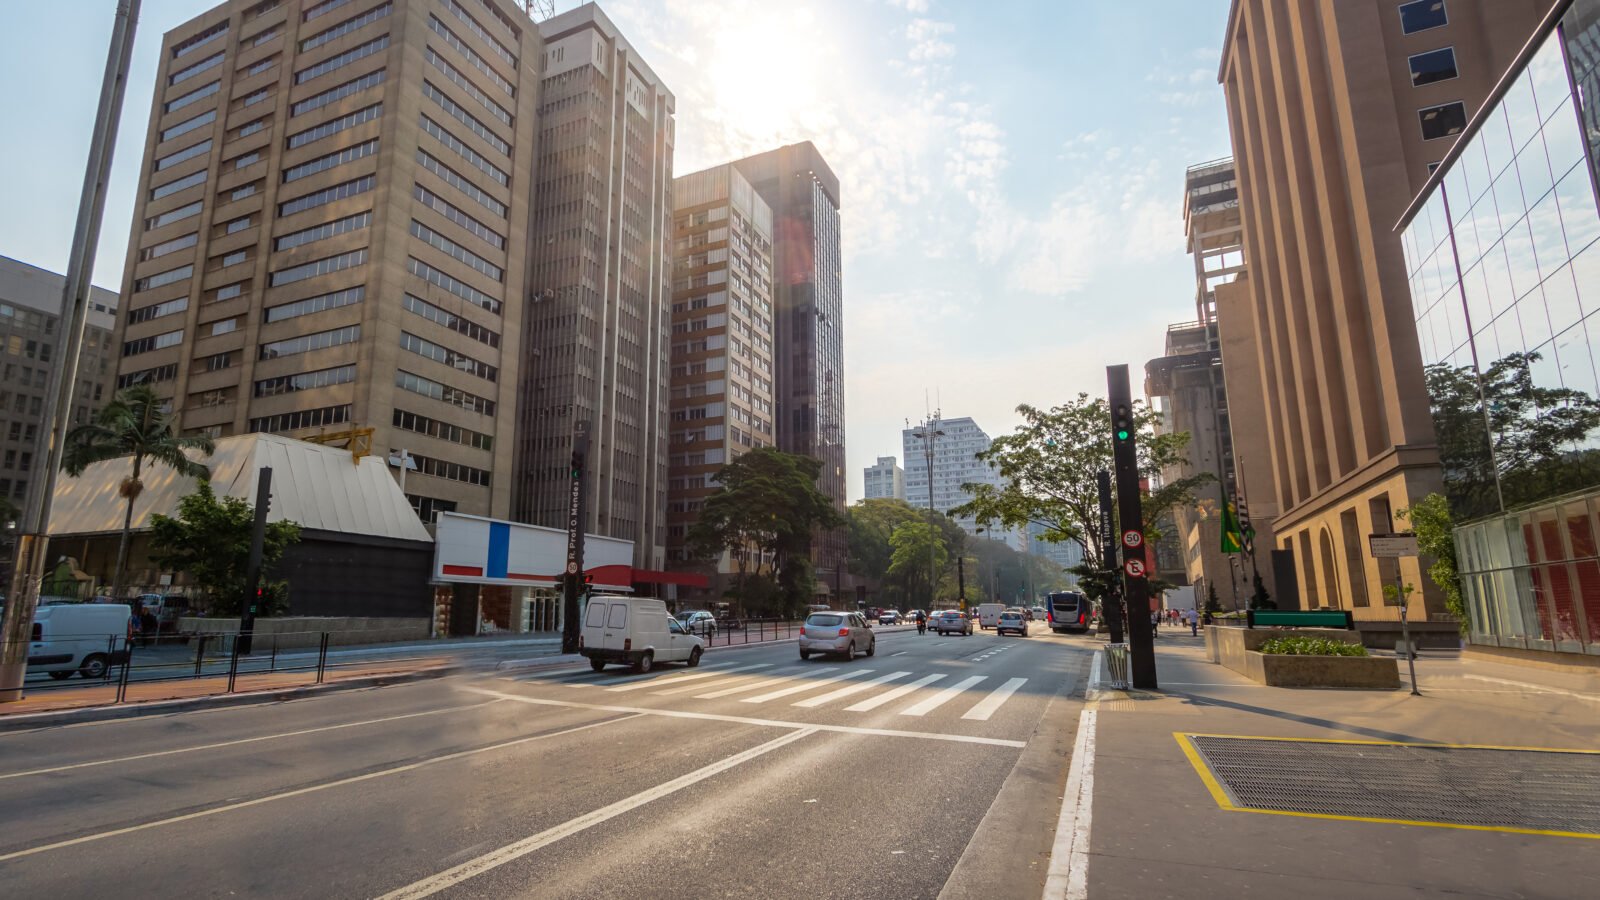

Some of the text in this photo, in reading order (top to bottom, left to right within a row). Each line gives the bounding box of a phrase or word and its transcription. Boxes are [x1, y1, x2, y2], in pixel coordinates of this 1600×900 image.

[571, 481, 579, 516] Mendes
[569, 527, 577, 549] Prof.
[1126, 534, 1139, 542] 50
